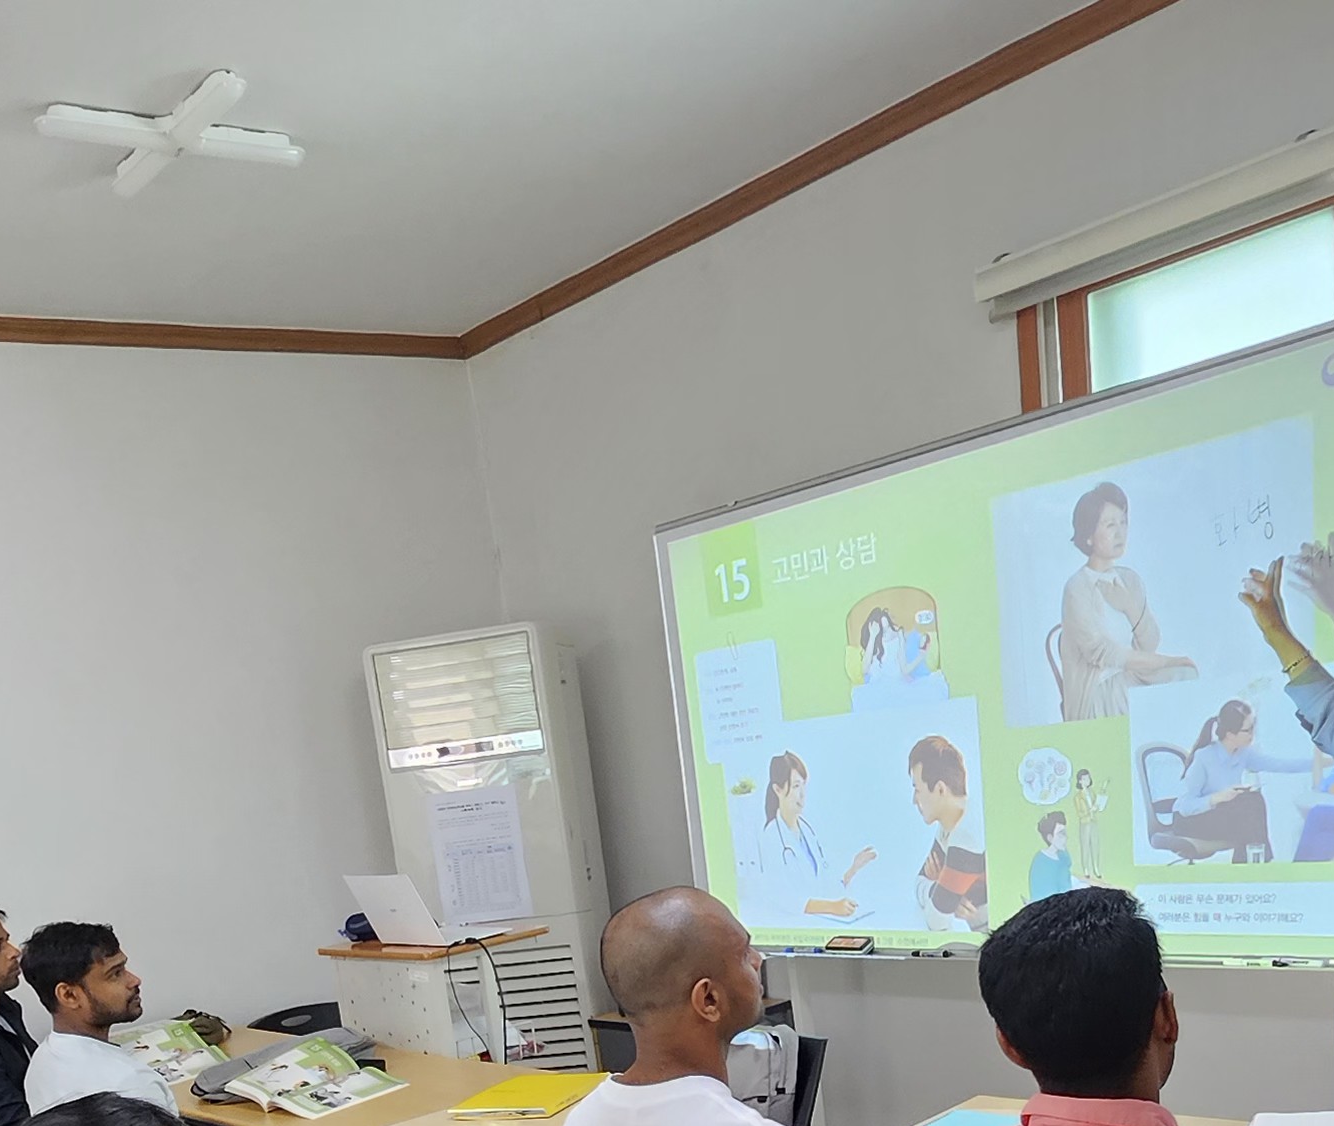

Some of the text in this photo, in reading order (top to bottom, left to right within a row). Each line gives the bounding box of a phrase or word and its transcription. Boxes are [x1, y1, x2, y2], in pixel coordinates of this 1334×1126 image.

[714, 558, 752, 603] 15
[771, 532, 877, 584] 고민과 상담
